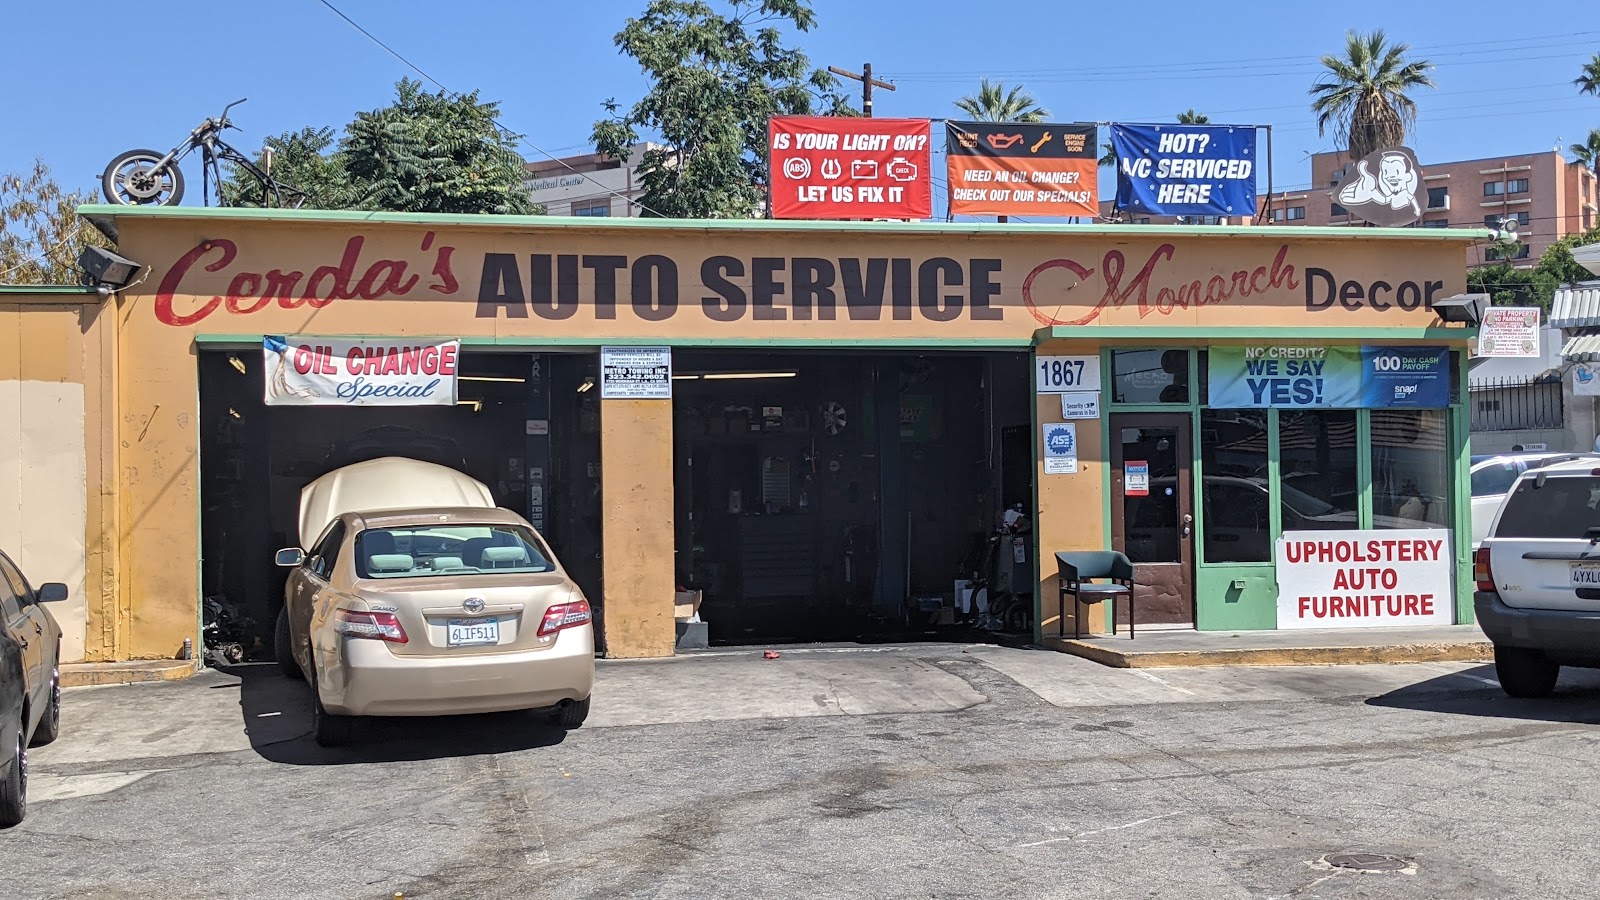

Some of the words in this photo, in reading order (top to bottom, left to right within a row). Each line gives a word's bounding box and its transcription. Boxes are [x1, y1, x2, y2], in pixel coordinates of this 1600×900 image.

[773, 132, 790, 149] IS
[795, 133, 839, 150] YOUR
[842, 134, 890, 151] LIGHT
[893, 135, 927, 151] ON?
[1158, 133, 1210, 153] HOT?
[790, 164, 804, 172] ABS
[964, 170, 992, 182] NEED
[994, 171, 1009, 182] AN
[1012, 171, 1027, 183] OIL
[1032, 171, 1079, 184] CHANGE?
[1122, 158, 1152, 178] A/C
[1156, 158, 1252, 179] SERVICED
[798, 186, 827, 202] LET
[831, 187, 853, 202] US
[858, 187, 884, 202] FIX
[888, 187, 904, 202] IT
[953, 188, 987, 200] CHECK
[990, 189, 1010, 201] OUT
[1013, 190, 1035, 202] OUR
[1037, 190, 1091, 203] SPECIALS!
[1157, 184, 1212, 204] HERE
[154, 231, 459, 326] Cerda's
[475, 252, 679, 322] AUTO
[700, 255, 1004, 322] SERVICE
[1022, 243, 1300, 327] Monarch
[1304, 266, 1443, 313] Decor
[292, 345, 338, 376] OIL
[346, 345, 456, 376] CHANGE
[1246, 348, 1265, 358] NO
[1269, 347, 1326, 358] CREDIT?
[1041, 361, 1084, 386] 1867
[1246, 360, 1278, 375] WE
[1286, 360, 1325, 376] SAY
[1373, 356, 1401, 371] 100
[336, 376, 440, 404] Special
[1246, 378, 1323, 404] YES!
[1394, 384, 1418, 394] snap!
[1051, 435, 1069, 445] ASE
[1286, 540, 1442, 563] UPHOLSTERY
[1333, 568, 1398, 590] AUTO
[1298, 594, 1434, 618] FURNITURE
[453, 627, 496, 640] 6LIF511
